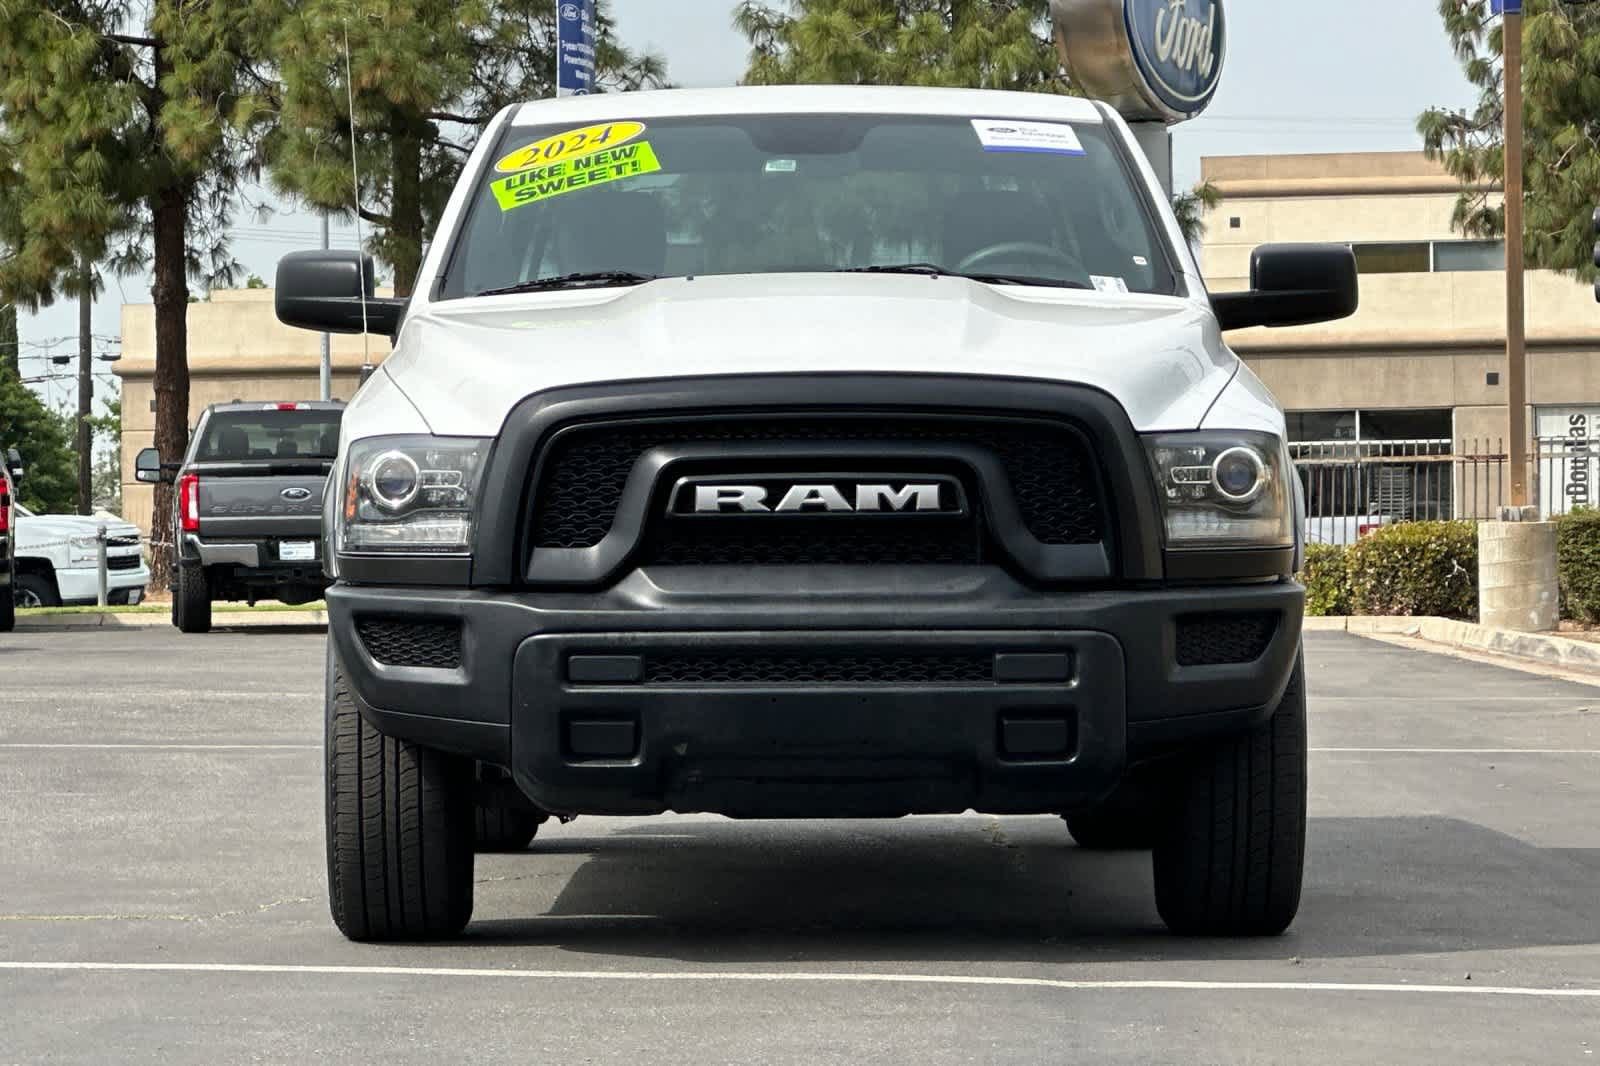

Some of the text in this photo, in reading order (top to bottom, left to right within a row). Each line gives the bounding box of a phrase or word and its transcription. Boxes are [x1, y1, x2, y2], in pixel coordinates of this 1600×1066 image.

[1154, 0, 1215, 79] Ford
[505, 145, 640, 191] LIKE NEW
[520, 126, 613, 168] 2024
[513, 160, 641, 202] SWEET!
[695, 484, 941, 512] RAM
